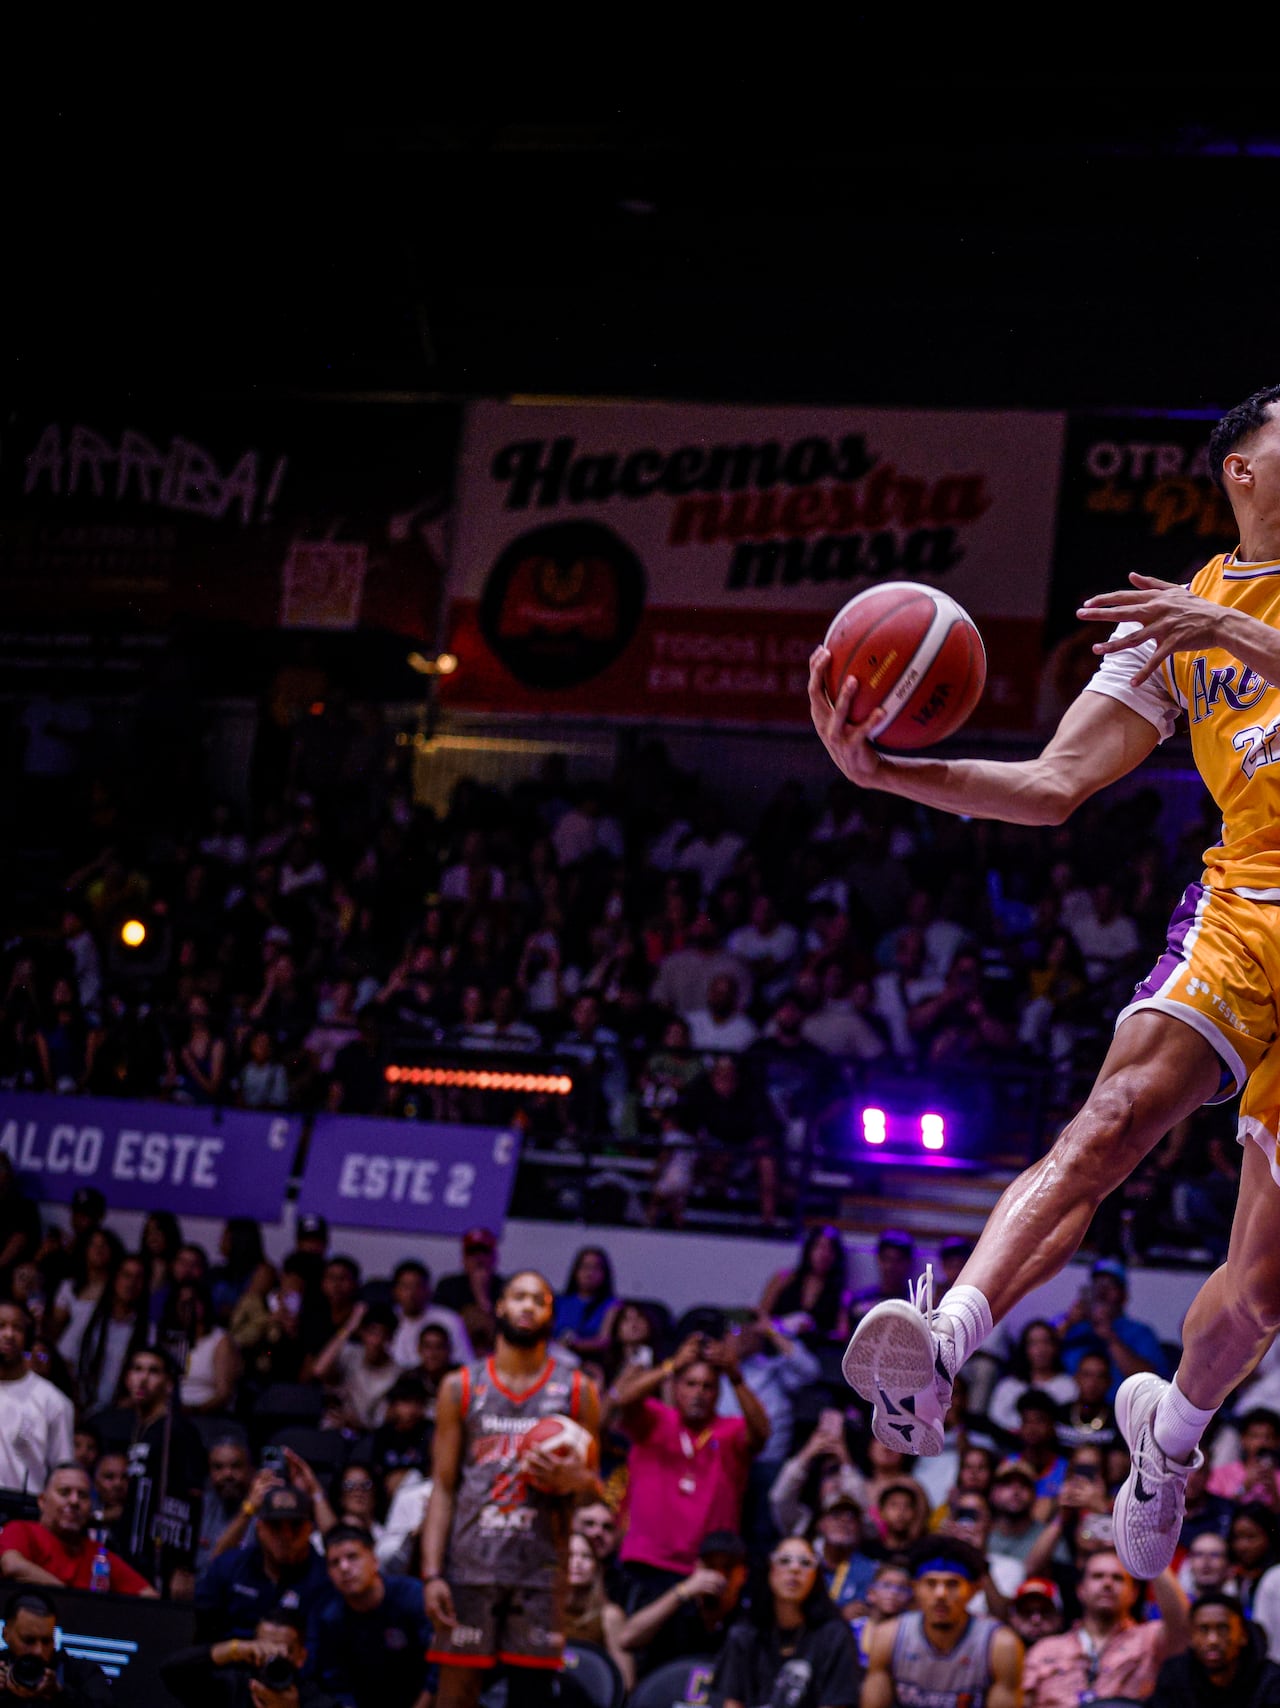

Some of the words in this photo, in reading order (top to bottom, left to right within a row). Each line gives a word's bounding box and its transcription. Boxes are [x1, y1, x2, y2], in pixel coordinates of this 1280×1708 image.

[492, 433, 876, 509] Hacemos
[668, 463, 993, 546] nuestra
[725, 525, 966, 590] masa
[0, 1118, 104, 1176] ALCO
[111, 1129, 225, 1189] ESTE
[338, 1151, 441, 1204] ESTE
[443, 1162, 478, 1209] 2
